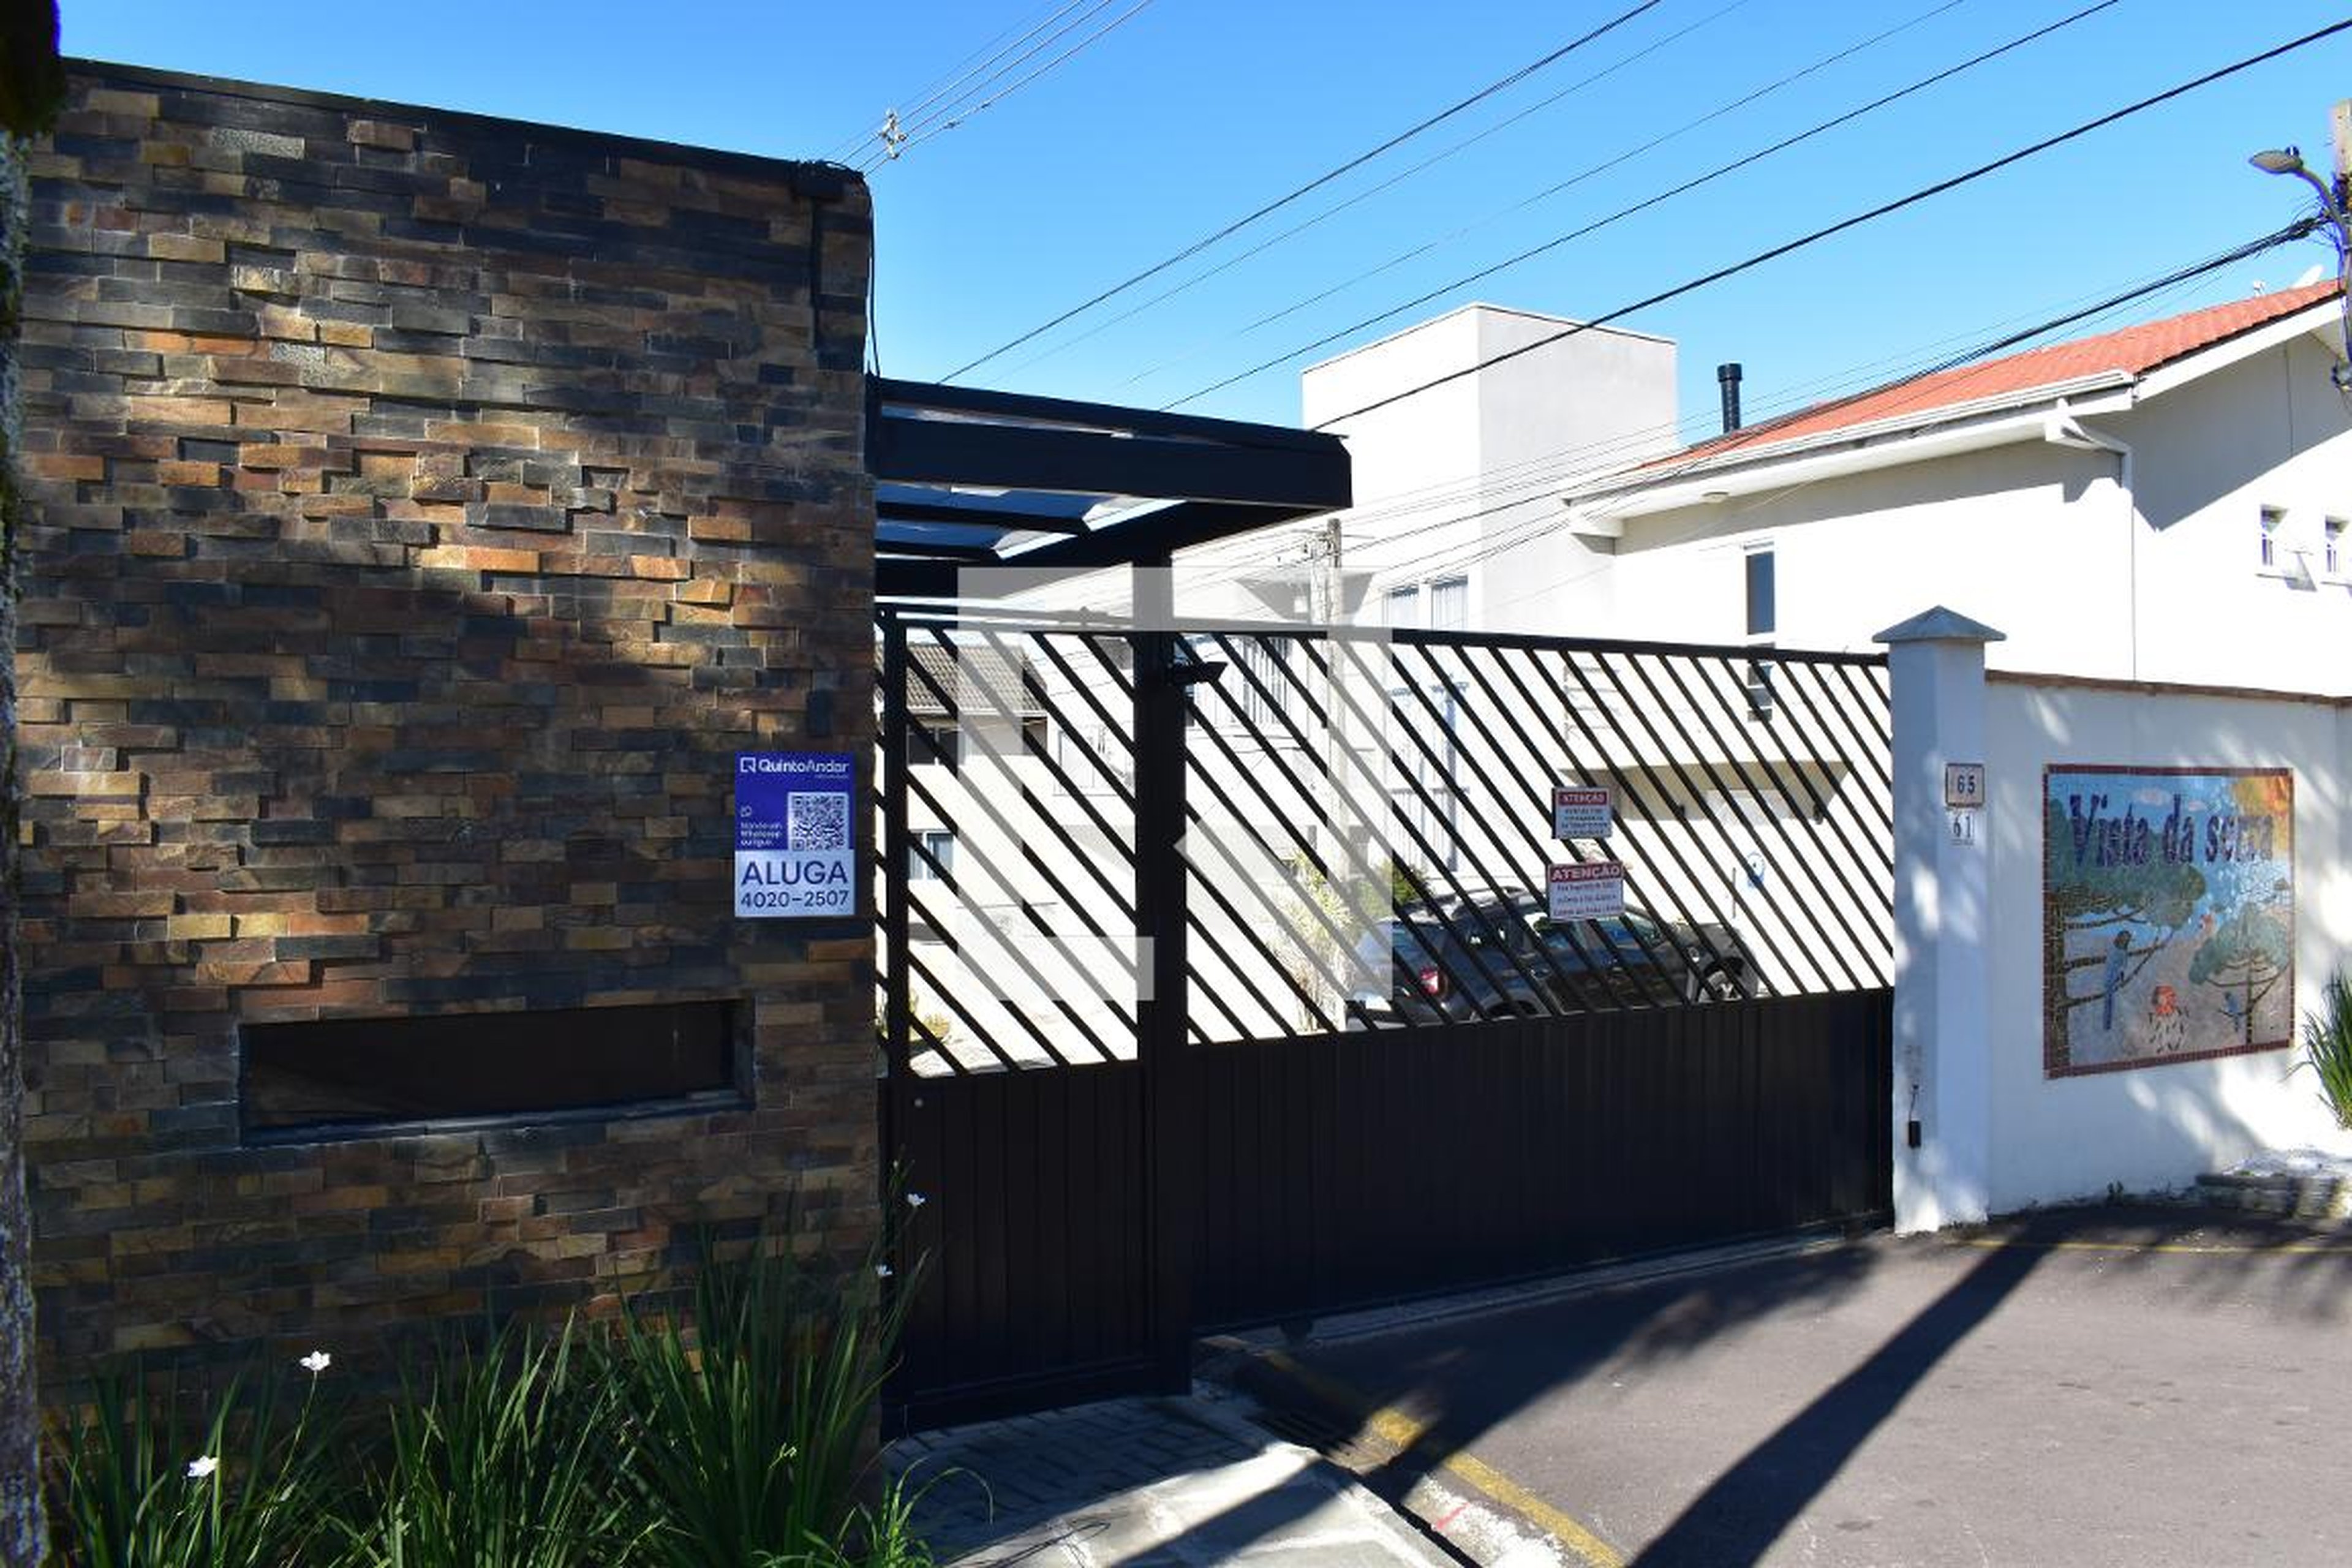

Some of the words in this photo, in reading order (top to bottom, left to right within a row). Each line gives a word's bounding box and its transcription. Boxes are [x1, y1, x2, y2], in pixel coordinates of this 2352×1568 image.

[1958, 775, 1975, 794] 65
[2163, 794, 2195, 865] da
[741, 861, 848, 886] ALUGA
[741, 890, 849, 908] 4020-2507
